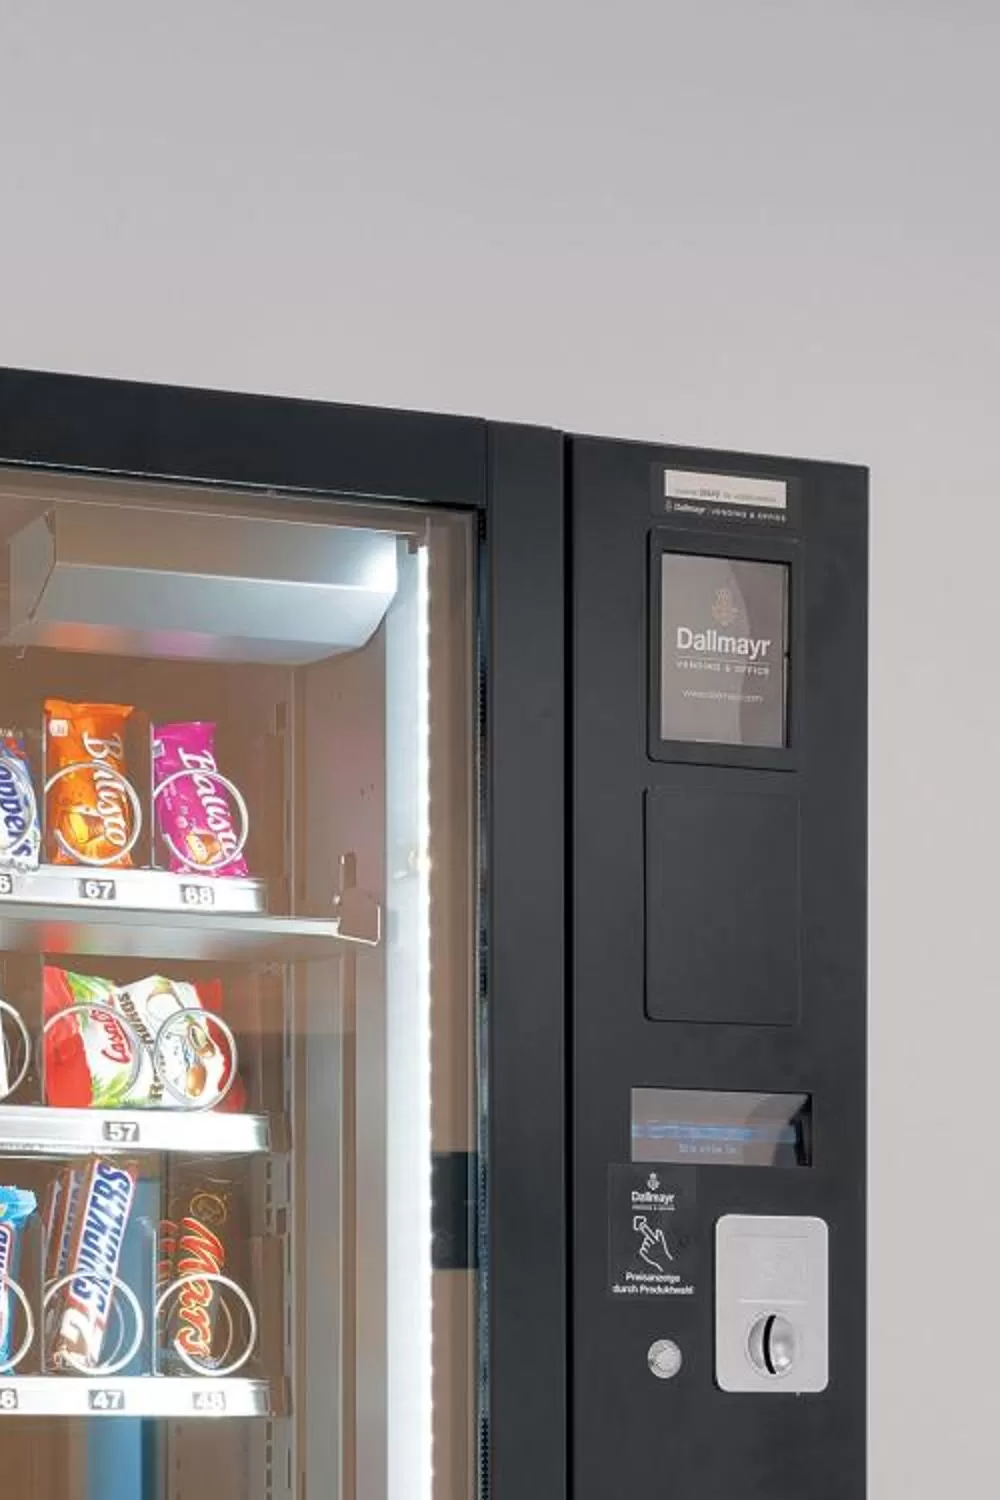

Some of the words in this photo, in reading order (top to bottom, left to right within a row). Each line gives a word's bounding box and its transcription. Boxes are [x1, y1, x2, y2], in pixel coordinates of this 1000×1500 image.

[676, 626, 771, 660] Dallmayr
[81, 731, 128, 847] Balisto
[85, 881, 114, 899] 67
[184, 887, 214, 905] 68
[108, 1122, 137, 1142] 57
[175, 1216, 225, 1358] Mars
[93, 1391, 122, 1410] 47
